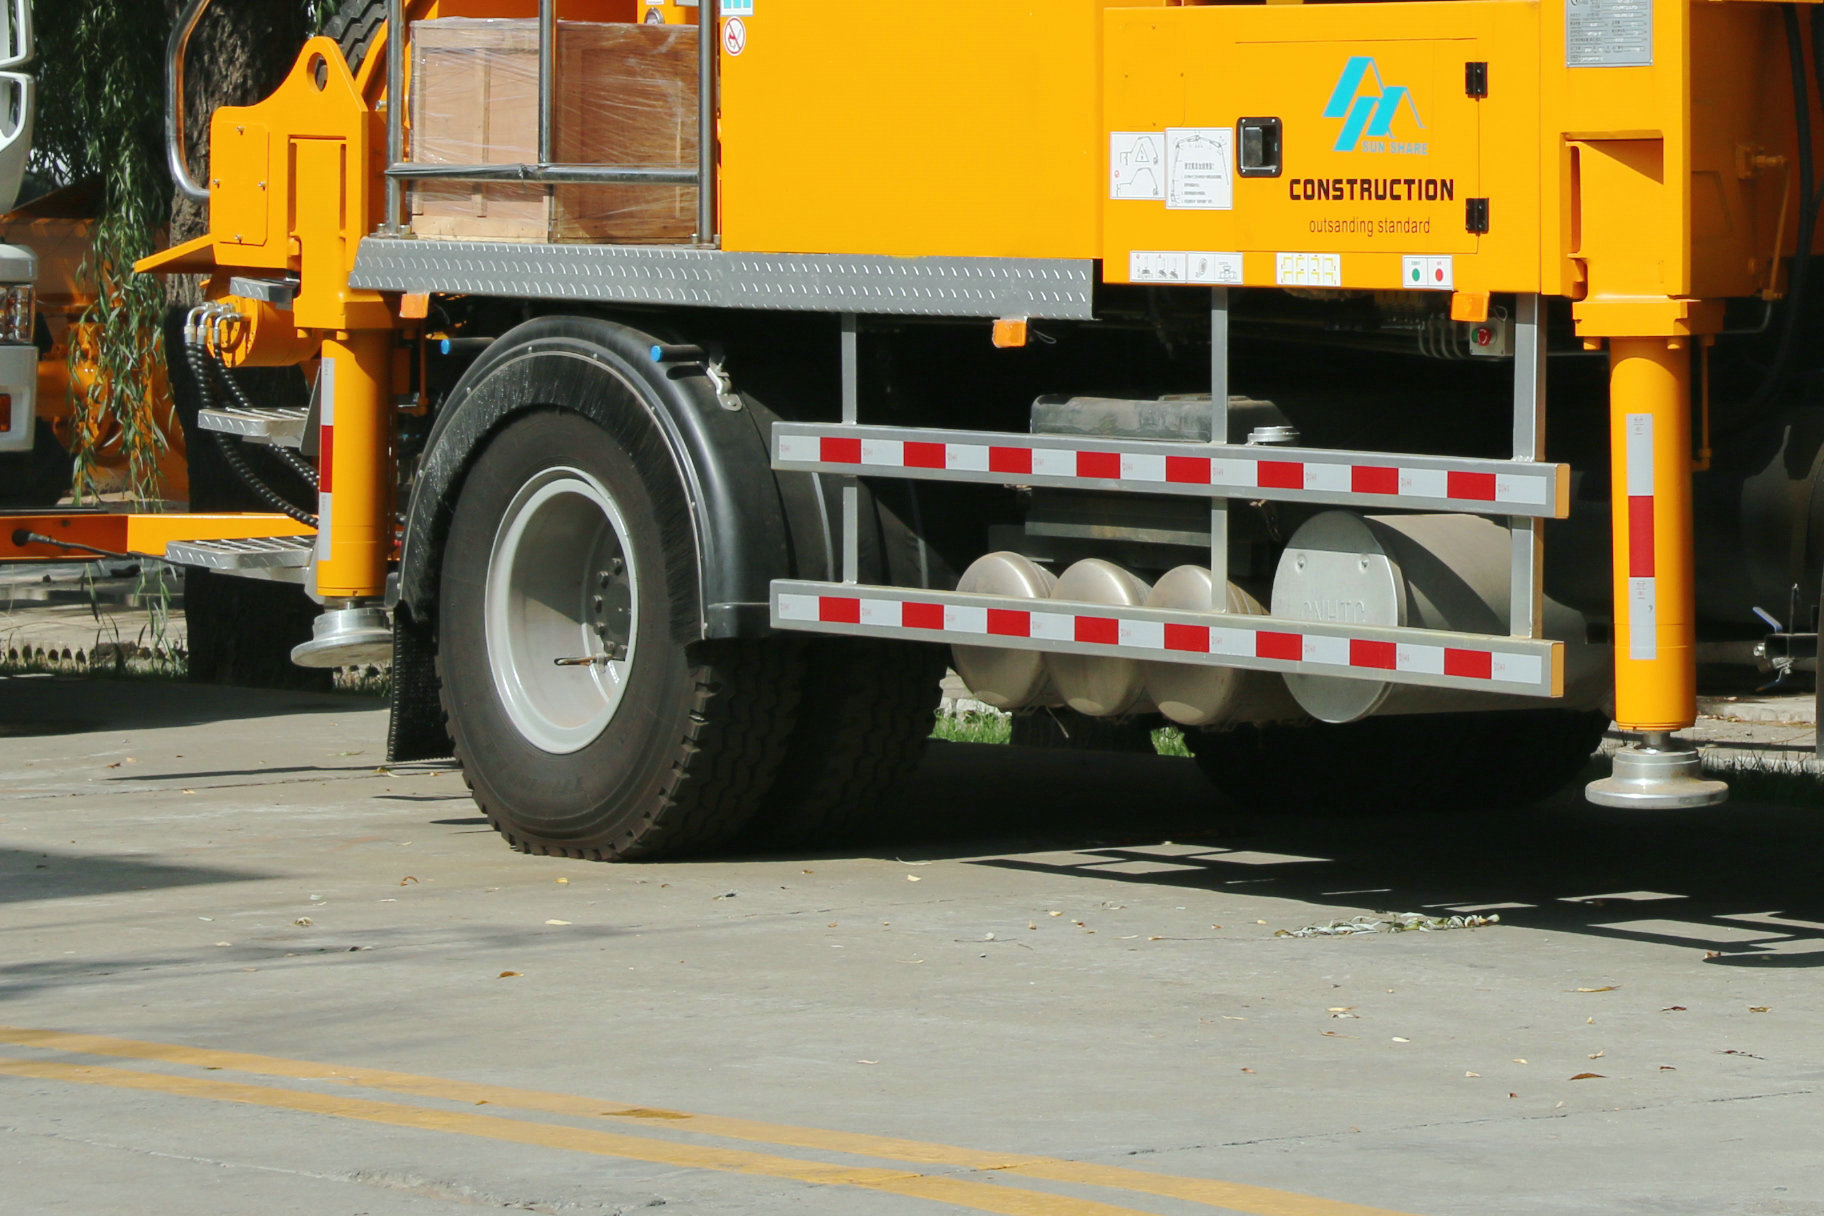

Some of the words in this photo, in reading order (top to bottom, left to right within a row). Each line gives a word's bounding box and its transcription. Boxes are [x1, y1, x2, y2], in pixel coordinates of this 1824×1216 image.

[1362, 140, 1384, 153] SUN
[1390, 142, 1428, 155] SHARE
[1289, 179, 1454, 201] CONSTRUCTION
[1309, 216, 1374, 237] outsanding
[1378, 217, 1430, 233] standard
